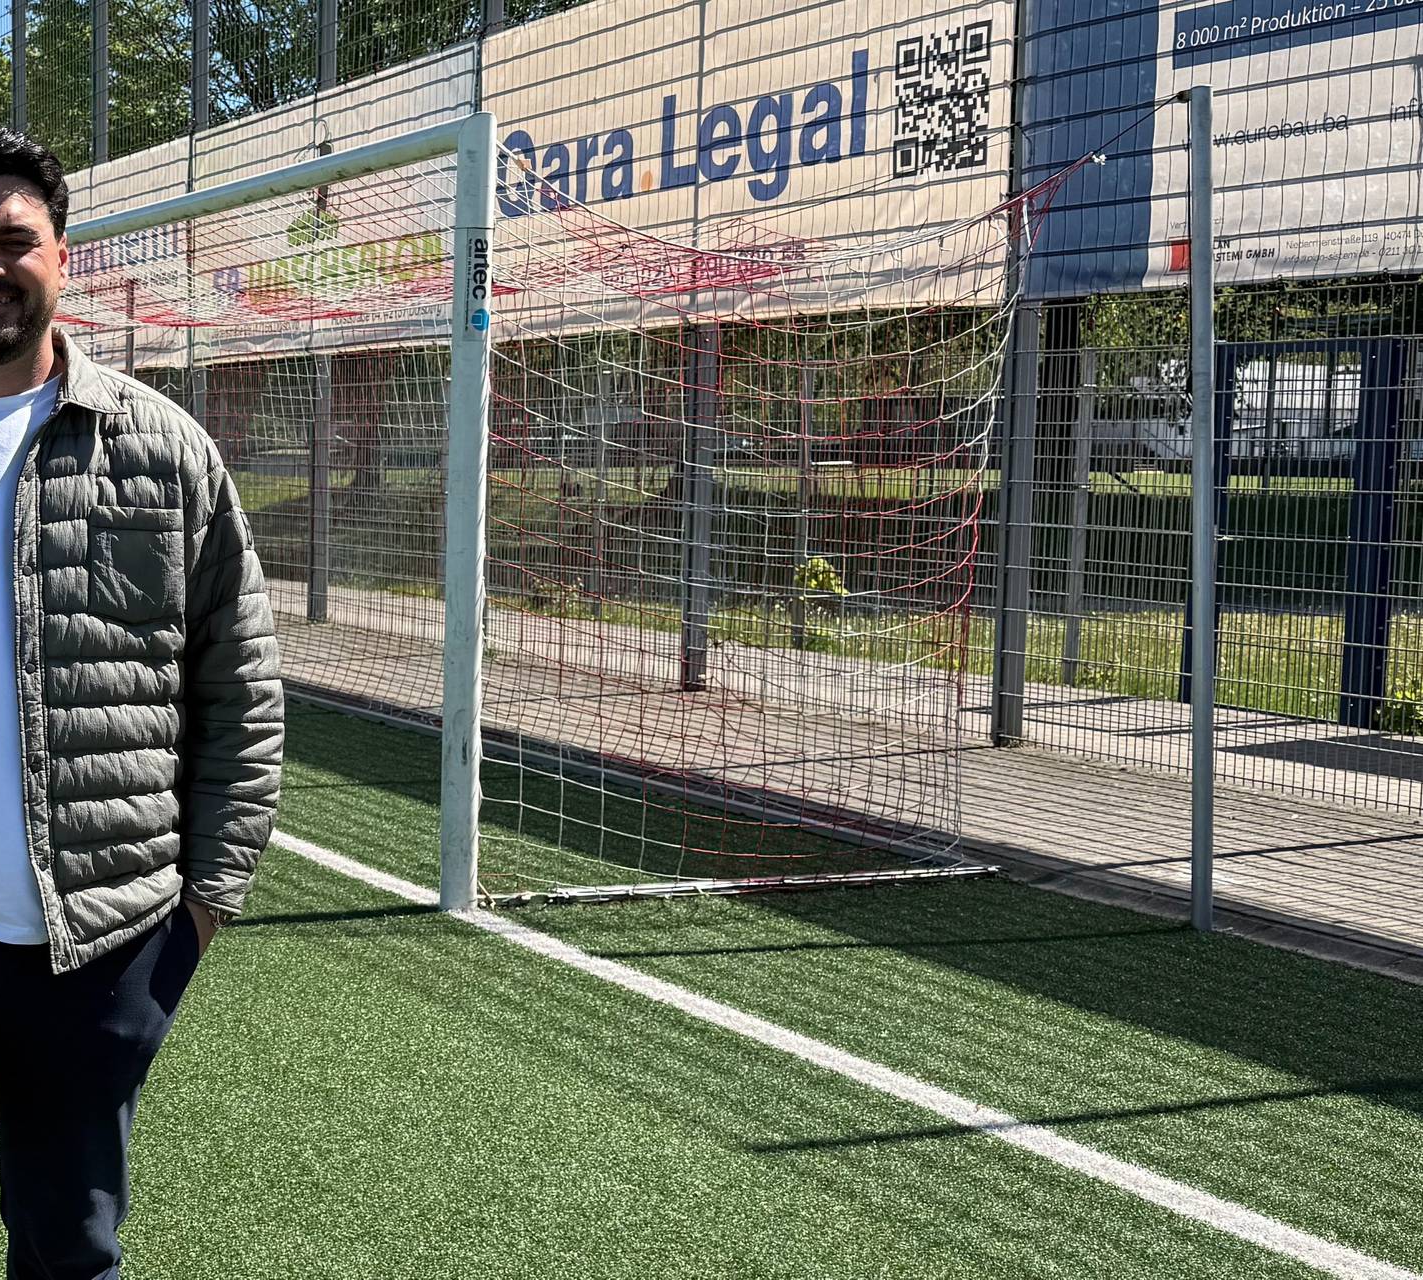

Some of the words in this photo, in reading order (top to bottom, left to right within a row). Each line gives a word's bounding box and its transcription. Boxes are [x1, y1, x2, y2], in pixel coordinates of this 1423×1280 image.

[1177, 32, 1186, 49] 8
[1190, 26, 1219, 46] 000
[1250, 2, 1345, 35] Produktion
[472, 238, 489, 300] artec
